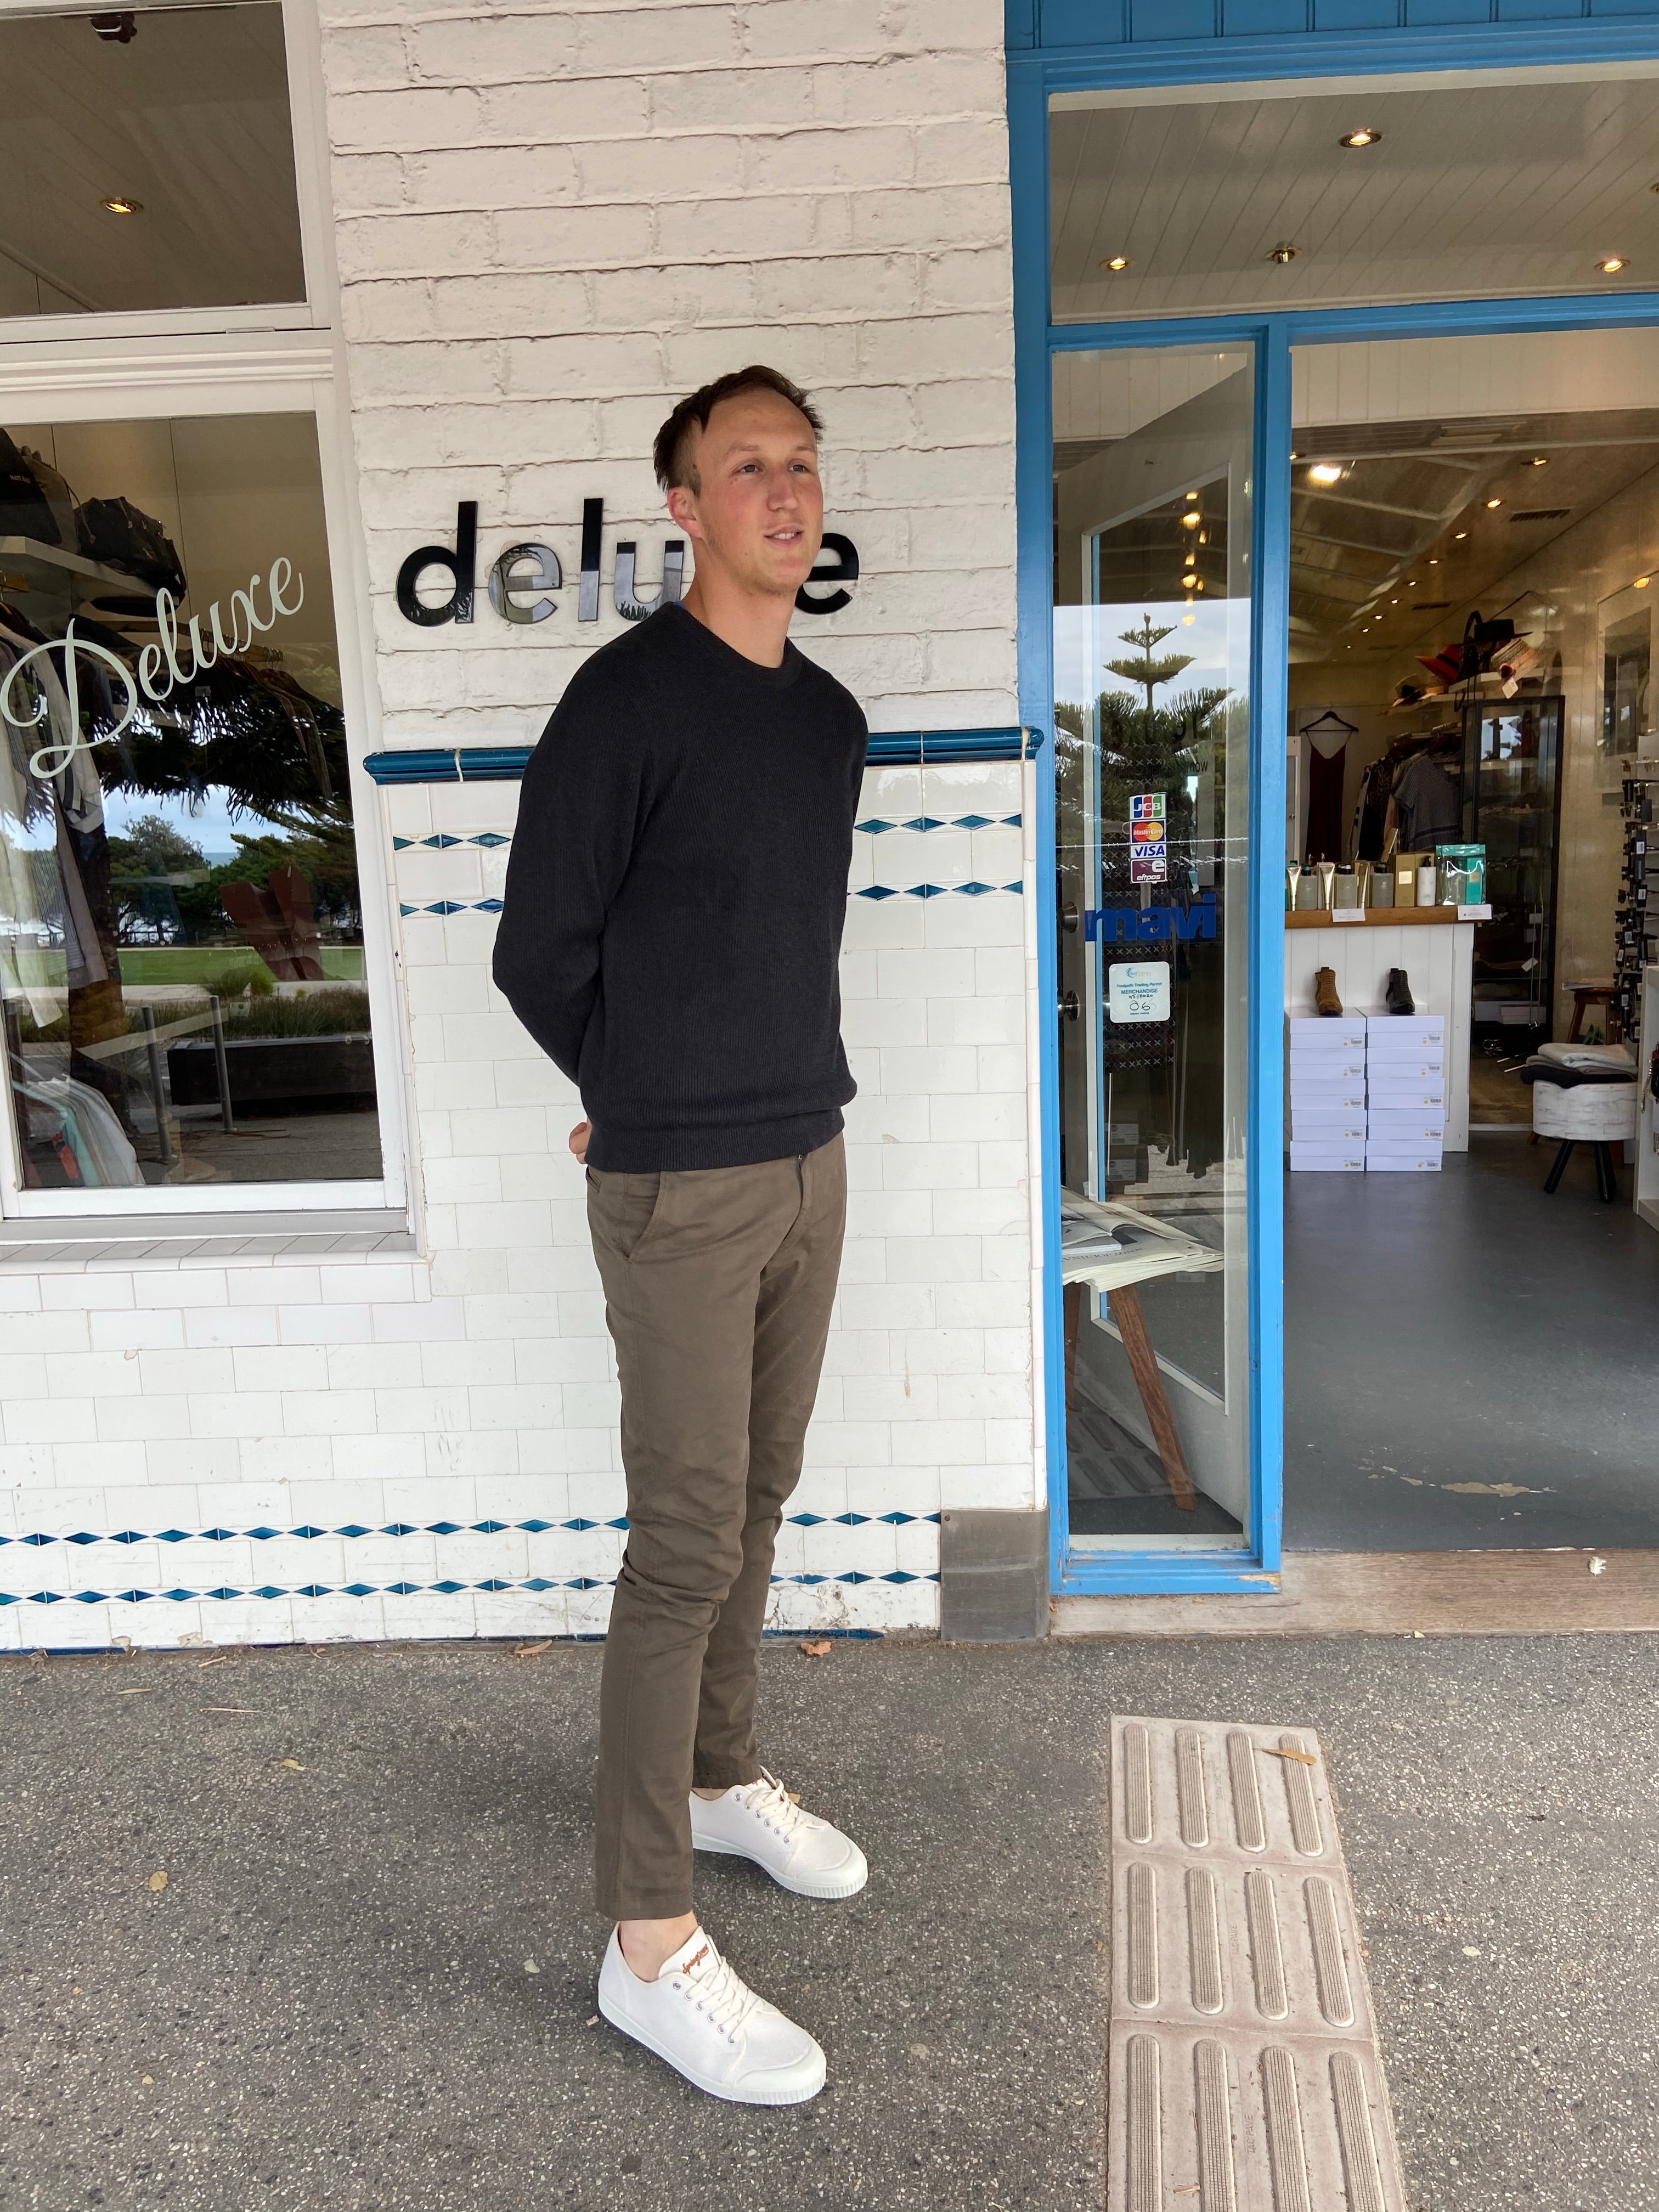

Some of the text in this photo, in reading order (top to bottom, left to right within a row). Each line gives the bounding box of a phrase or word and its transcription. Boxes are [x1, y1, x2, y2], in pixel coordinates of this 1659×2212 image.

[396, 497, 859, 627] delue
[0, 556, 305, 779] Deluxe
[1133, 802, 1161, 811] JCB
[1134, 845, 1165, 857] VISA
[1085, 893, 1216, 941] mavi
[1244, 2114, 1256, 2154] TAC PAVE
